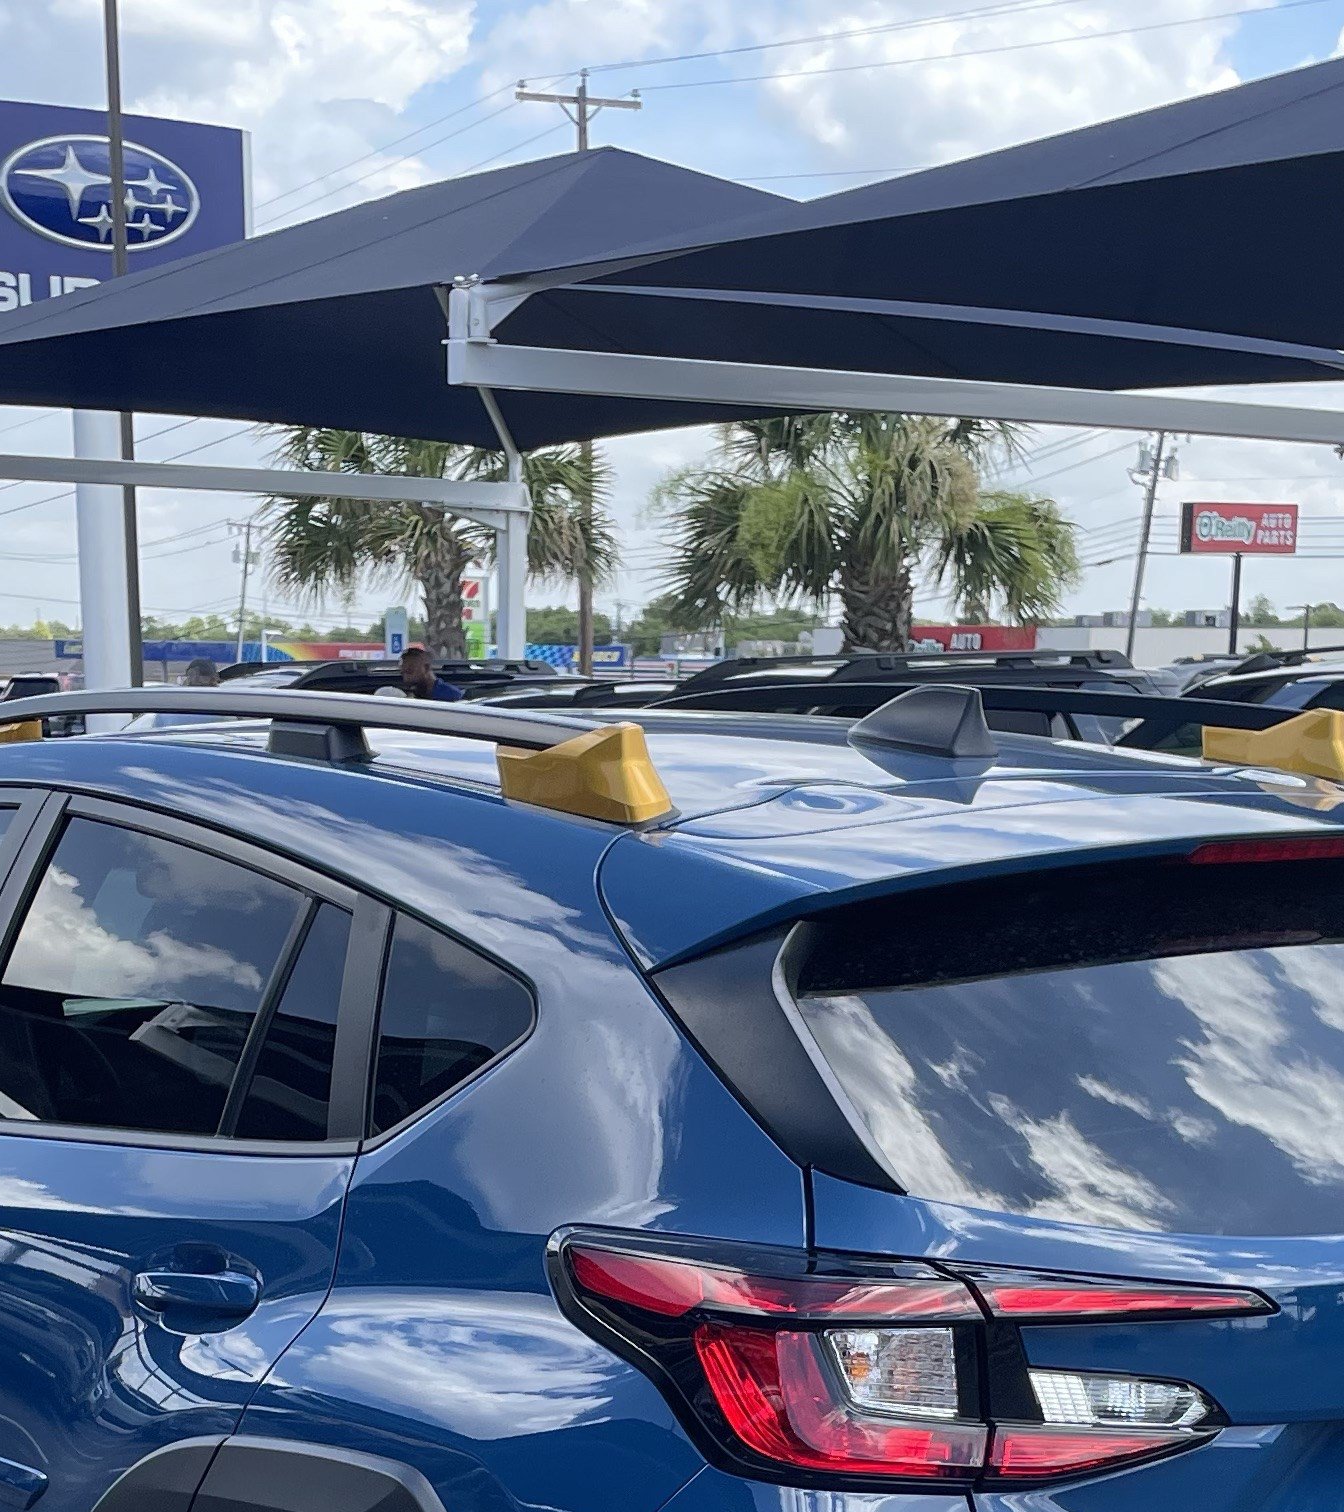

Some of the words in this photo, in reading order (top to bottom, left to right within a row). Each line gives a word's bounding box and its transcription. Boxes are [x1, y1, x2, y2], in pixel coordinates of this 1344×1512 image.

[1260, 512, 1292, 529] AUTO
[1256, 529, 1295, 546] PARTS
[949, 633, 982, 650] AUTO
